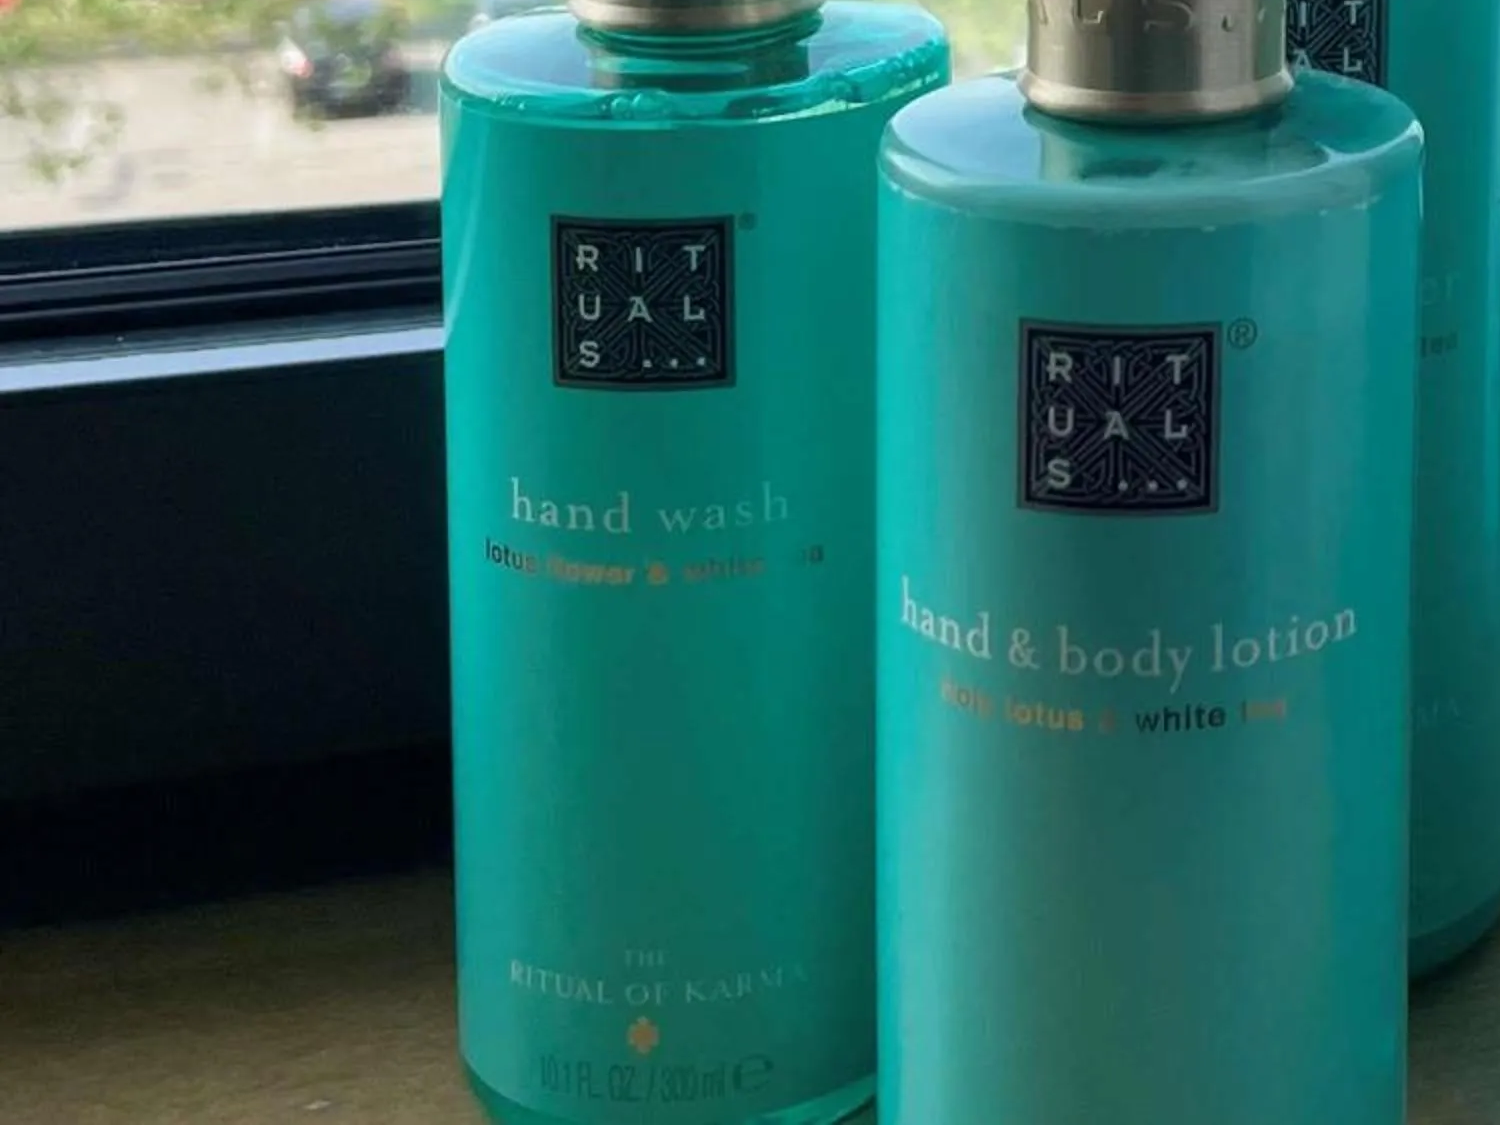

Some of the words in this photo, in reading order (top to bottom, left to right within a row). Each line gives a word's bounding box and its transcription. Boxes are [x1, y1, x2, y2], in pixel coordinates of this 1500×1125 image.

[510, 477, 632, 534] hand
[658, 481, 791, 535] wash
[485, 537, 537, 573] lotus
[900, 574, 993, 661] hand
[1007, 628, 1040, 671] &
[1058, 625, 1194, 694] body
[1210, 606, 1358, 673] lotion
[1006, 694, 1085, 732] lotus
[1135, 700, 1227, 734] white
[510, 957, 614, 1006] RITUAL
[624, 980, 670, 1006] OF
